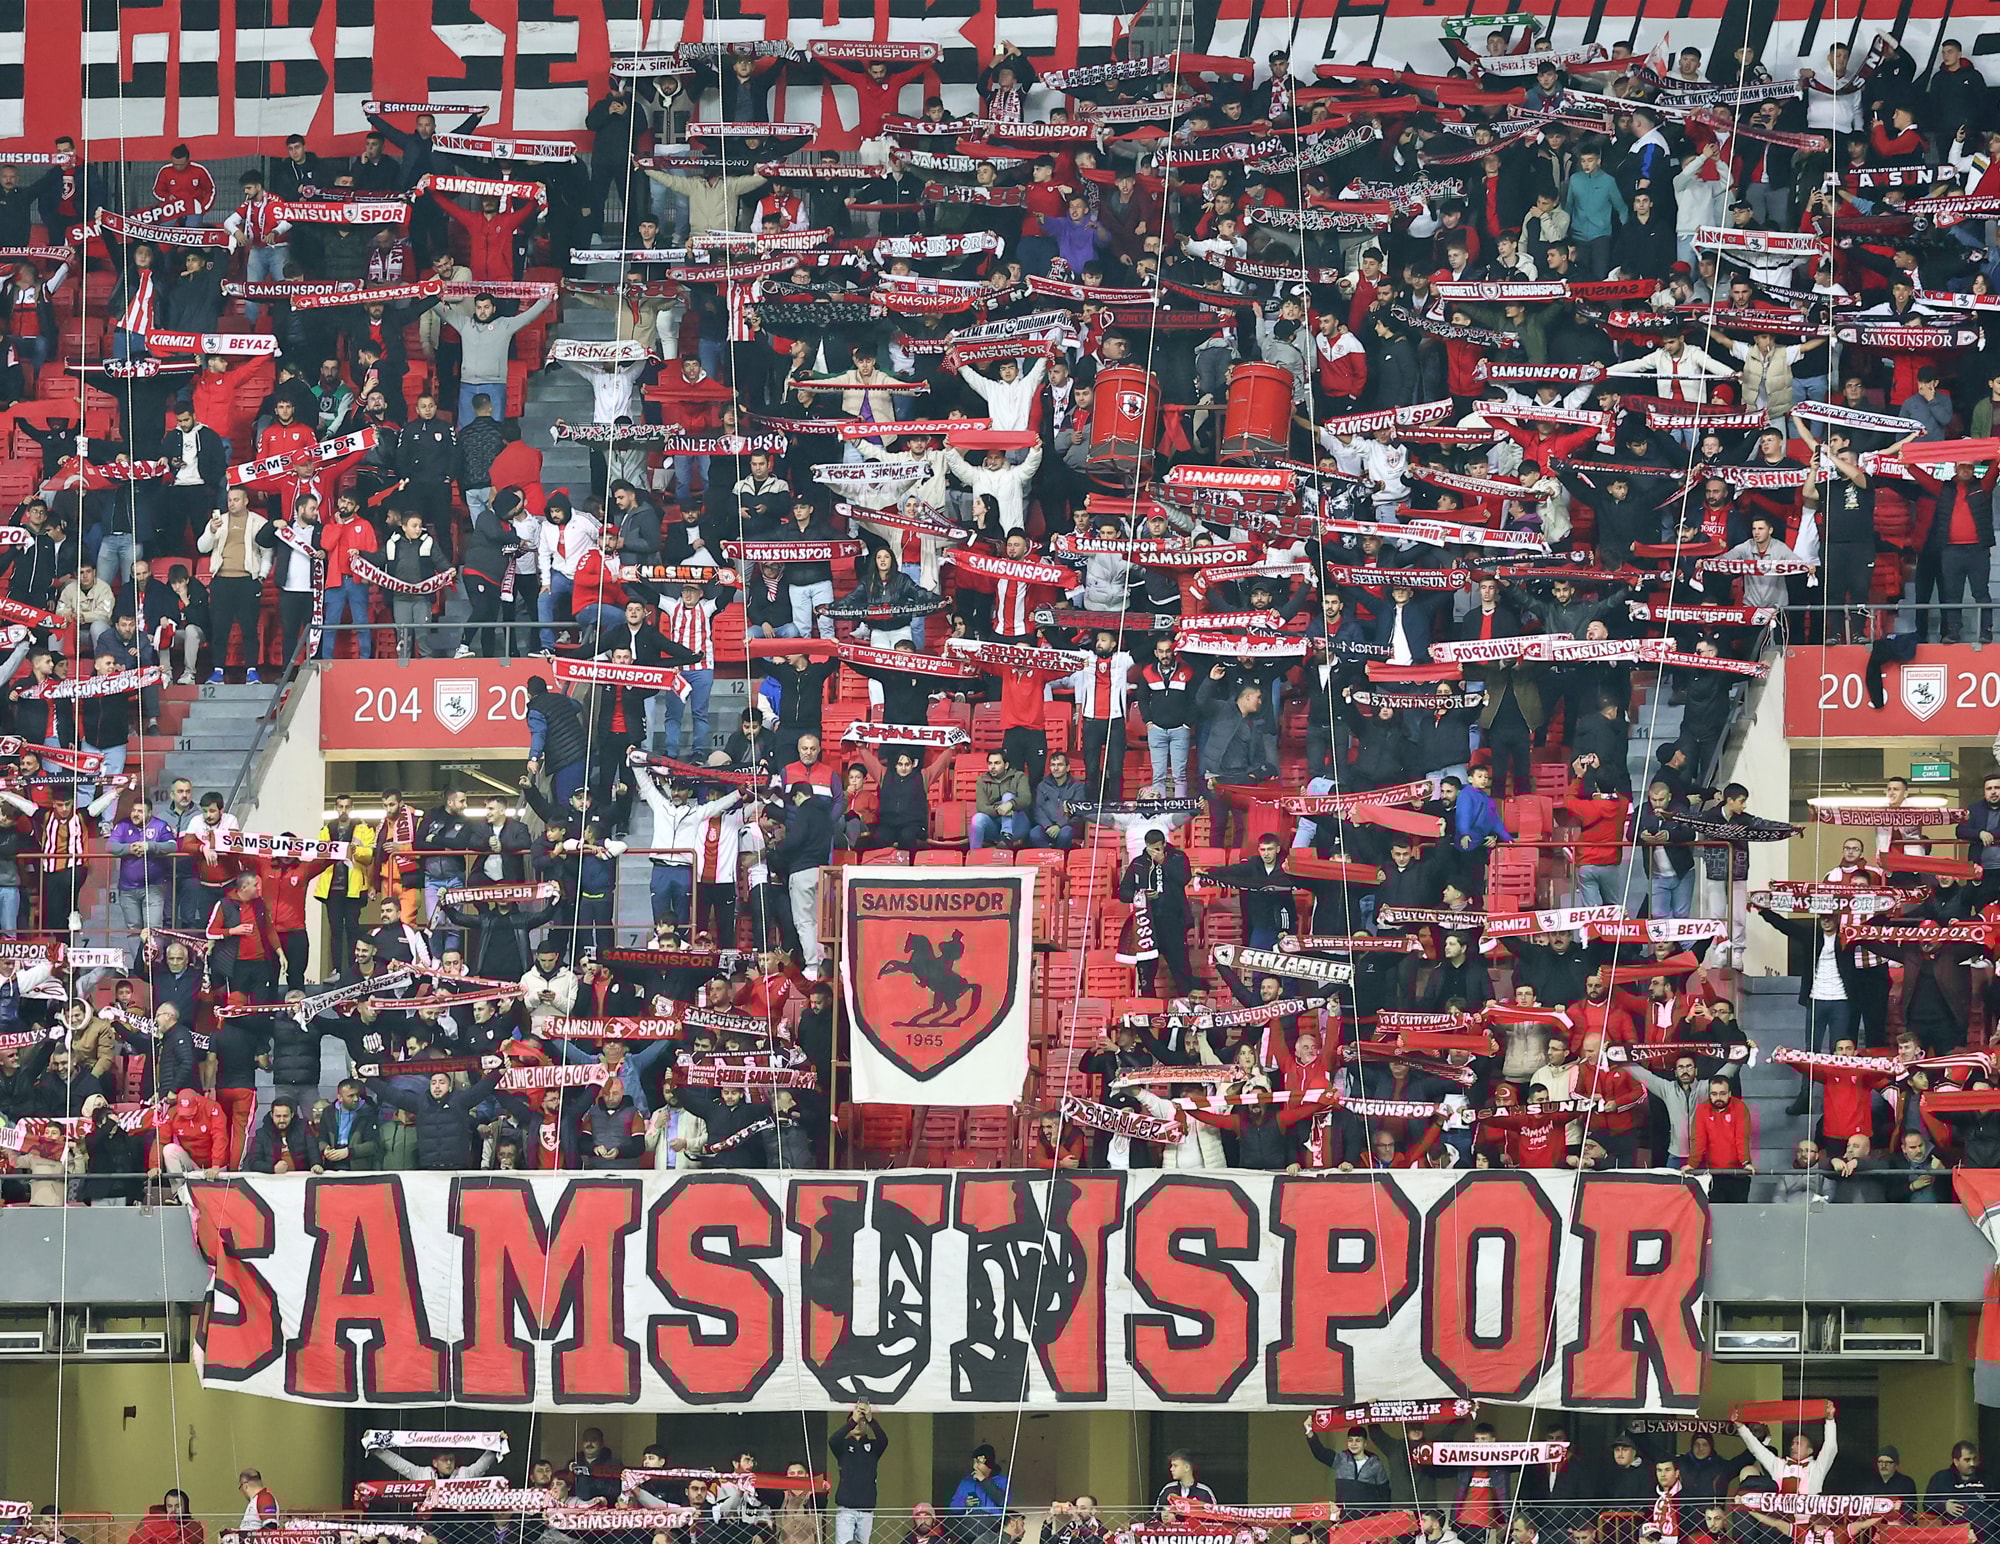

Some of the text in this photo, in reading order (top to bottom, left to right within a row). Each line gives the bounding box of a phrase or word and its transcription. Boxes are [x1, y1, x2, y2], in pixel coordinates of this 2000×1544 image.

[829, 47, 919, 58] SAMSUNSPOR
[612, 61, 646, 72] FORZA
[1000, 124, 1088, 138] SAMSUNSPOR
[435, 135, 474, 150] KING
[522, 145, 533, 154] THE
[533, 144, 572, 158] NORTH
[436, 176, 533, 199] SAMSUNSPOR
[273, 206, 403, 223] SAMSUN SPOR
[122, 223, 204, 246] SAMSUNSPOR
[757, 236, 829, 252] SAMSUNSPOR
[889, 240, 981, 255] SAMSUNSPOR
[687, 262, 783, 282] SAMSUNSPOR
[1236, 260, 1310, 280] SAMSUNSPOR
[248, 282, 333, 297] SAMSUNSPOR
[446, 284, 533, 298] SAMSUNSPOR
[1088, 290, 1142, 301] Samsunspor
[1501, 283, 1564, 297] SAMSUNSPOR
[1769, 285, 1819, 302] SAMSUNSPOR
[888, 294, 968, 307] SAMSUNSPOR
[150, 334, 272, 351] KIRMIZI BEYAZ
[1861, 332, 1953, 347] SAMSUNSPOR
[959, 344, 1046, 362] SAMSUNSPOR
[1491, 365, 1578, 379] SAMSUNSPOR
[1327, 403, 1453, 436] SAMSUN SPOR
[1654, 412, 1759, 426] samsun
[667, 435, 717, 452] RİNLER
[246, 437, 356, 476] SAMSSPOR
[828, 467, 866, 480] FORZA
[1184, 470, 1281, 487] SAMSUNSPOR
[1434, 475, 1526, 498] SAMSUNSPOR
[746, 547, 833, 560] SAMSUNSPOR
[1076, 538, 1157, 553] SAMSUNSPOR
[1140, 549, 1248, 566] SAMSUNSPOR
[641, 565, 714, 580] SAMSUN
[968, 555, 1062, 583] SAMSUNSPOR
[1351, 568, 1381, 576] BURASI
[1702, 559, 1756, 574] MSUN
[1394, 576, 1448, 589] SAMSUN
[858, 650, 890, 660] BURASI
[893, 654, 908, 662] HER
[910, 656, 927, 665] YER
[1554, 639, 1640, 662] SAMSUNSPOR
[875, 658, 938, 671] SAMSUN
[1647, 650, 1740, 669] SAMSUNSPOR
[569, 664, 664, 684] SAMSUNSPOR
[44, 675, 140, 700] SAMSUNSPOR
[201, 687, 216, 699] 12
[731, 681, 745, 694] 12
[354, 687, 423, 722] 204
[1371, 692, 1463, 710] SAMSUNSPOR
[713, 734, 725, 745] 11
[1637, 728, 1650, 739] 11
[179, 740, 191, 751] 11
[30, 776, 89, 785] SAMSUNSPOR
[1842, 809, 1943, 825] SAMSUNSPOR
[222, 834, 341, 855] SAMSUNSPOR
[861, 891, 1005, 912] SAMSUNSPOR
[1771, 893, 1874, 912] SAMSUNSPOR
[1569, 907, 1617, 923] BEYAZ
[1594, 921, 1720, 937] KIRMIZI BEYAZ
[1860, 925, 1969, 939] SAMSUNSPOR
[630, 934, 638, 945] 7
[1303, 937, 1403, 950] SAMSUNSPOR
[602, 950, 714, 968] SAMSUNSPOR
[1239, 949, 1353, 981] ŞEHZADELER
[684, 1007, 768, 1033] SAMSUNSPOR
[1215, 998, 1307, 1028] SAMSUNSPOR
[554, 1017, 675, 1037] SAMSUN SPOR
[905, 1033, 944, 1048] 1965
[1789, 1050, 1893, 1069] SAMSUNSPOR
[1345, 1100, 1434, 1117] AMSUNSPOR
[1085, 1107, 1162, 1139] ŞİRİNLER
[187, 1170, 1707, 1408] SAMSUNSPOR
[1345, 1402, 1442, 1420] 55 GENÇLİK
[1647, 1420, 1737, 1435] SAMSUNSPO
[405, 1431, 477, 1446] Samsunspor
[1439, 1447, 1540, 1463] SAMSUNSPOR
[384, 1482, 427, 1494] BEYAZ
[440, 1490, 542, 1507] SAMSUNSPOR
[1762, 1495, 1874, 1515] SAMSUNSPOR
[1203, 1503, 1292, 1519] SAMSUNSPOR
[569, 1513, 686, 1530] SAMSUNSPOR
